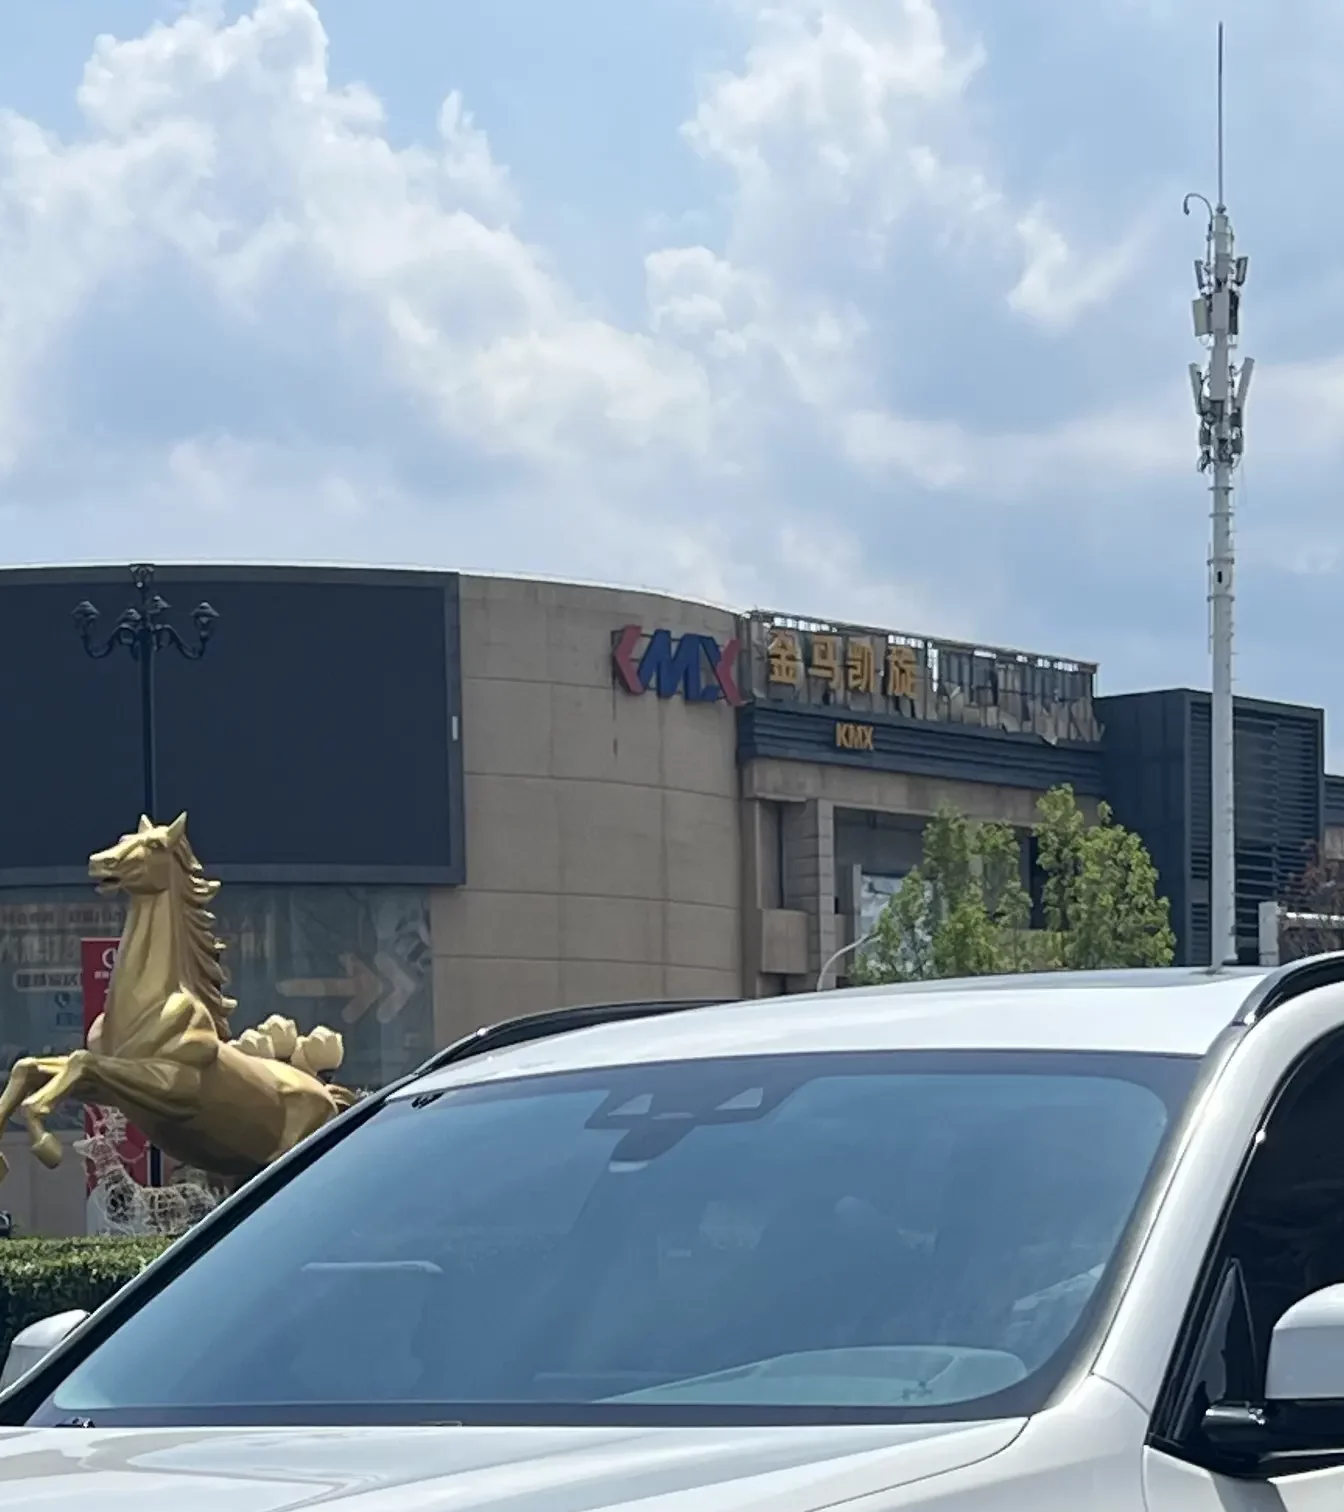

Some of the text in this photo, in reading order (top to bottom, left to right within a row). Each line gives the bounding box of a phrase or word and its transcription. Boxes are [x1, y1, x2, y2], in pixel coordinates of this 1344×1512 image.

[768, 629, 918, 699] 金马凯旋
[836, 722, 874, 750] KMX
